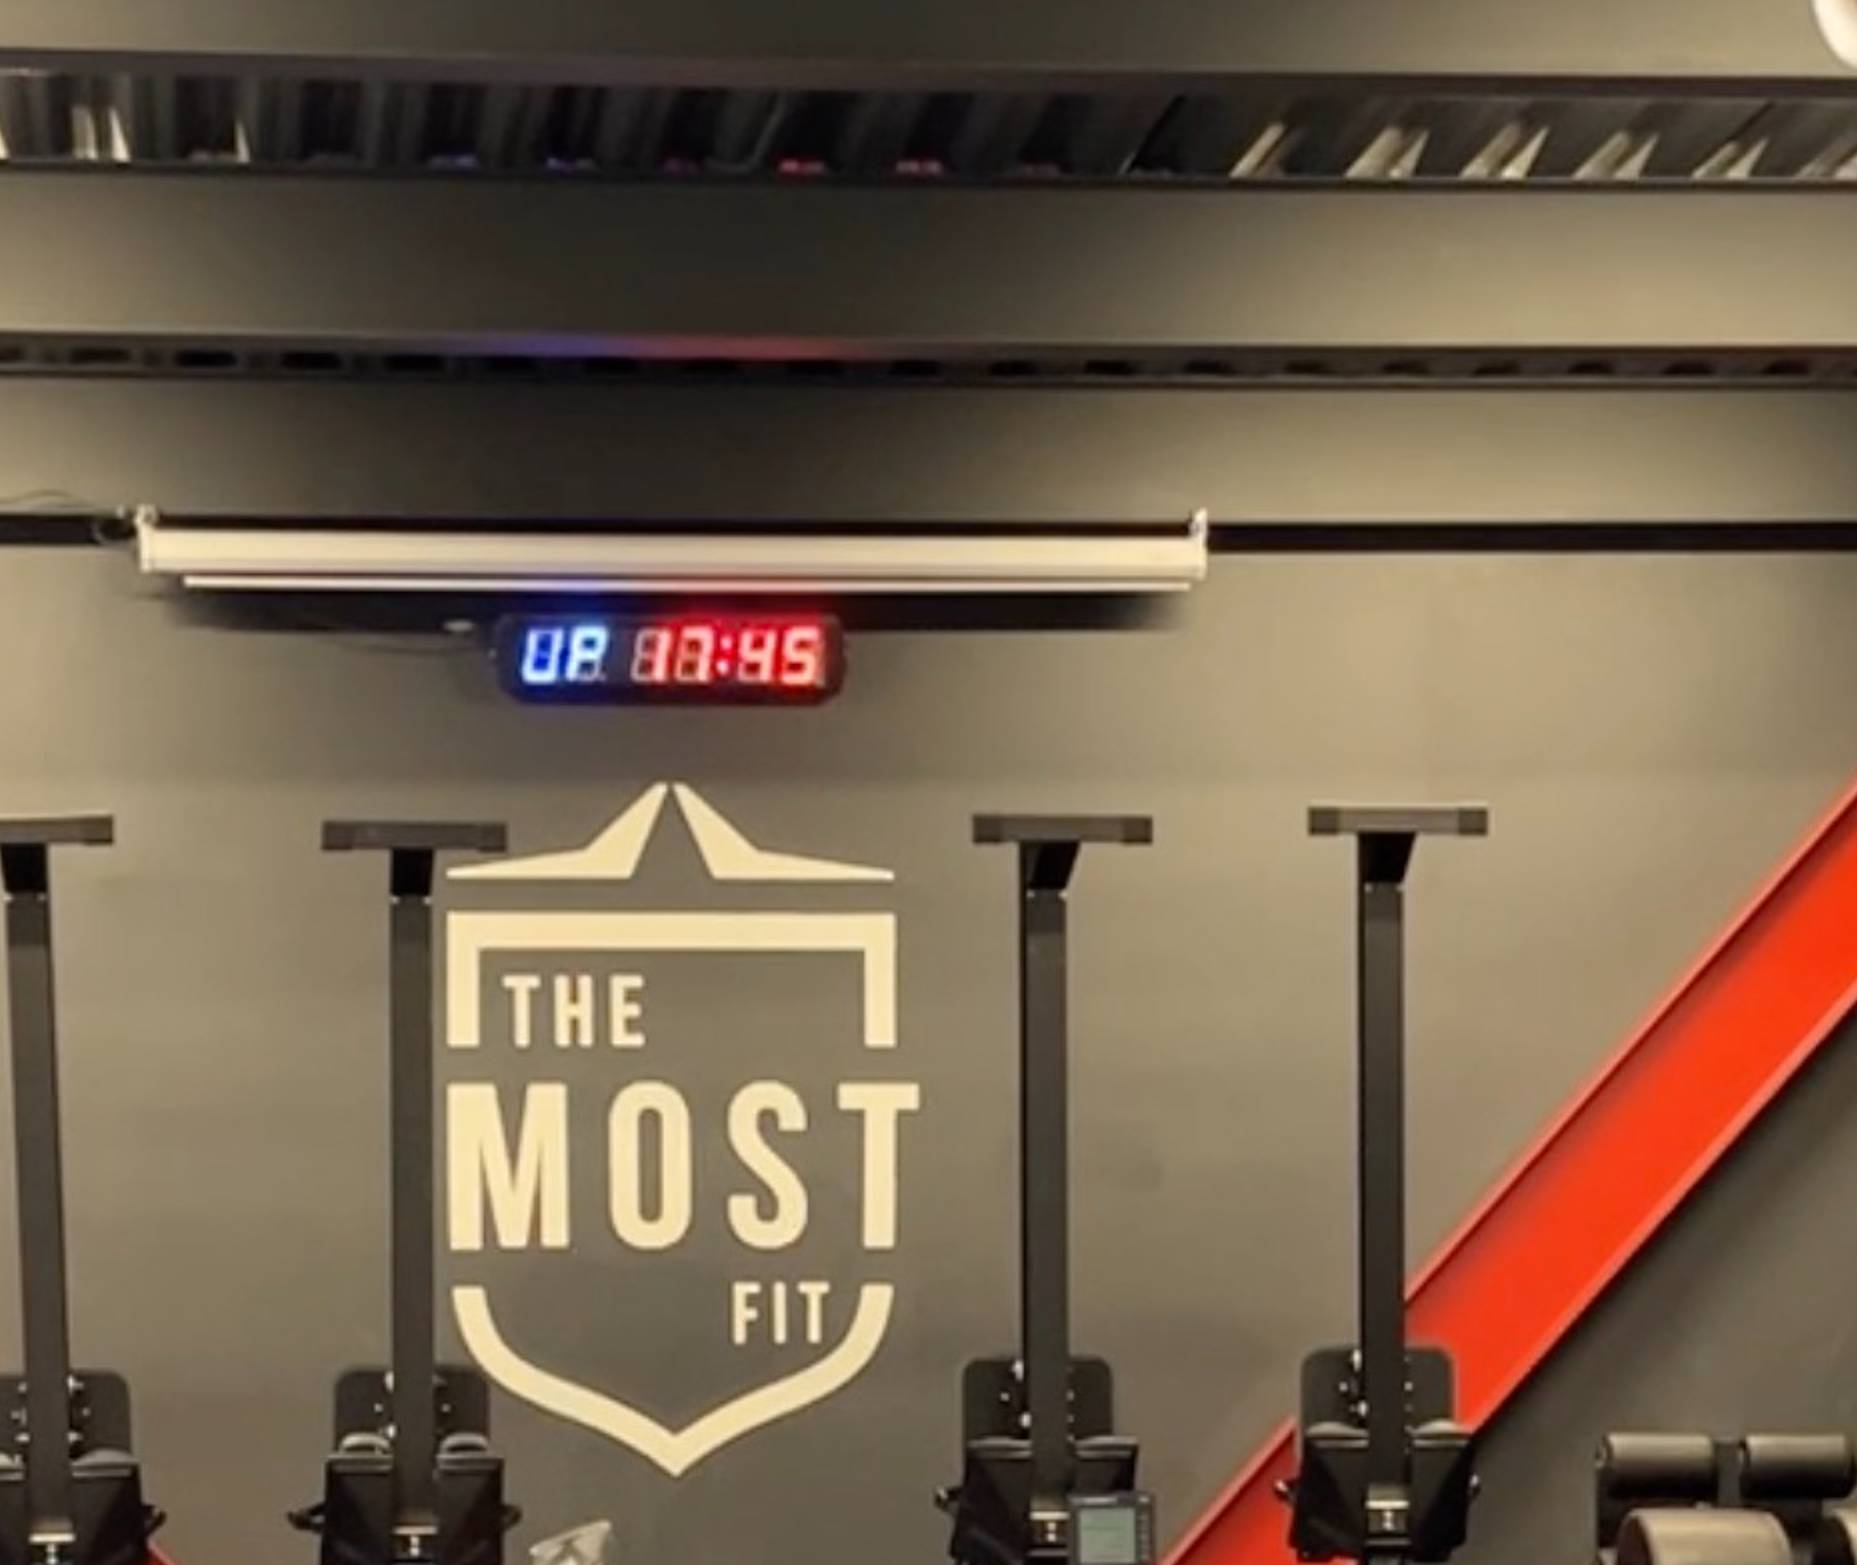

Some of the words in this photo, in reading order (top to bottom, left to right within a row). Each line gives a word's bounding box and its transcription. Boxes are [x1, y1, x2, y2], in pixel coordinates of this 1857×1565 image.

[522, 625, 609, 684] UP
[640, 625, 827, 685] 17:45
[503, 974, 646, 1048] THE
[446, 1080, 921, 1251] MOST
[733, 1281, 831, 1345] FIT
